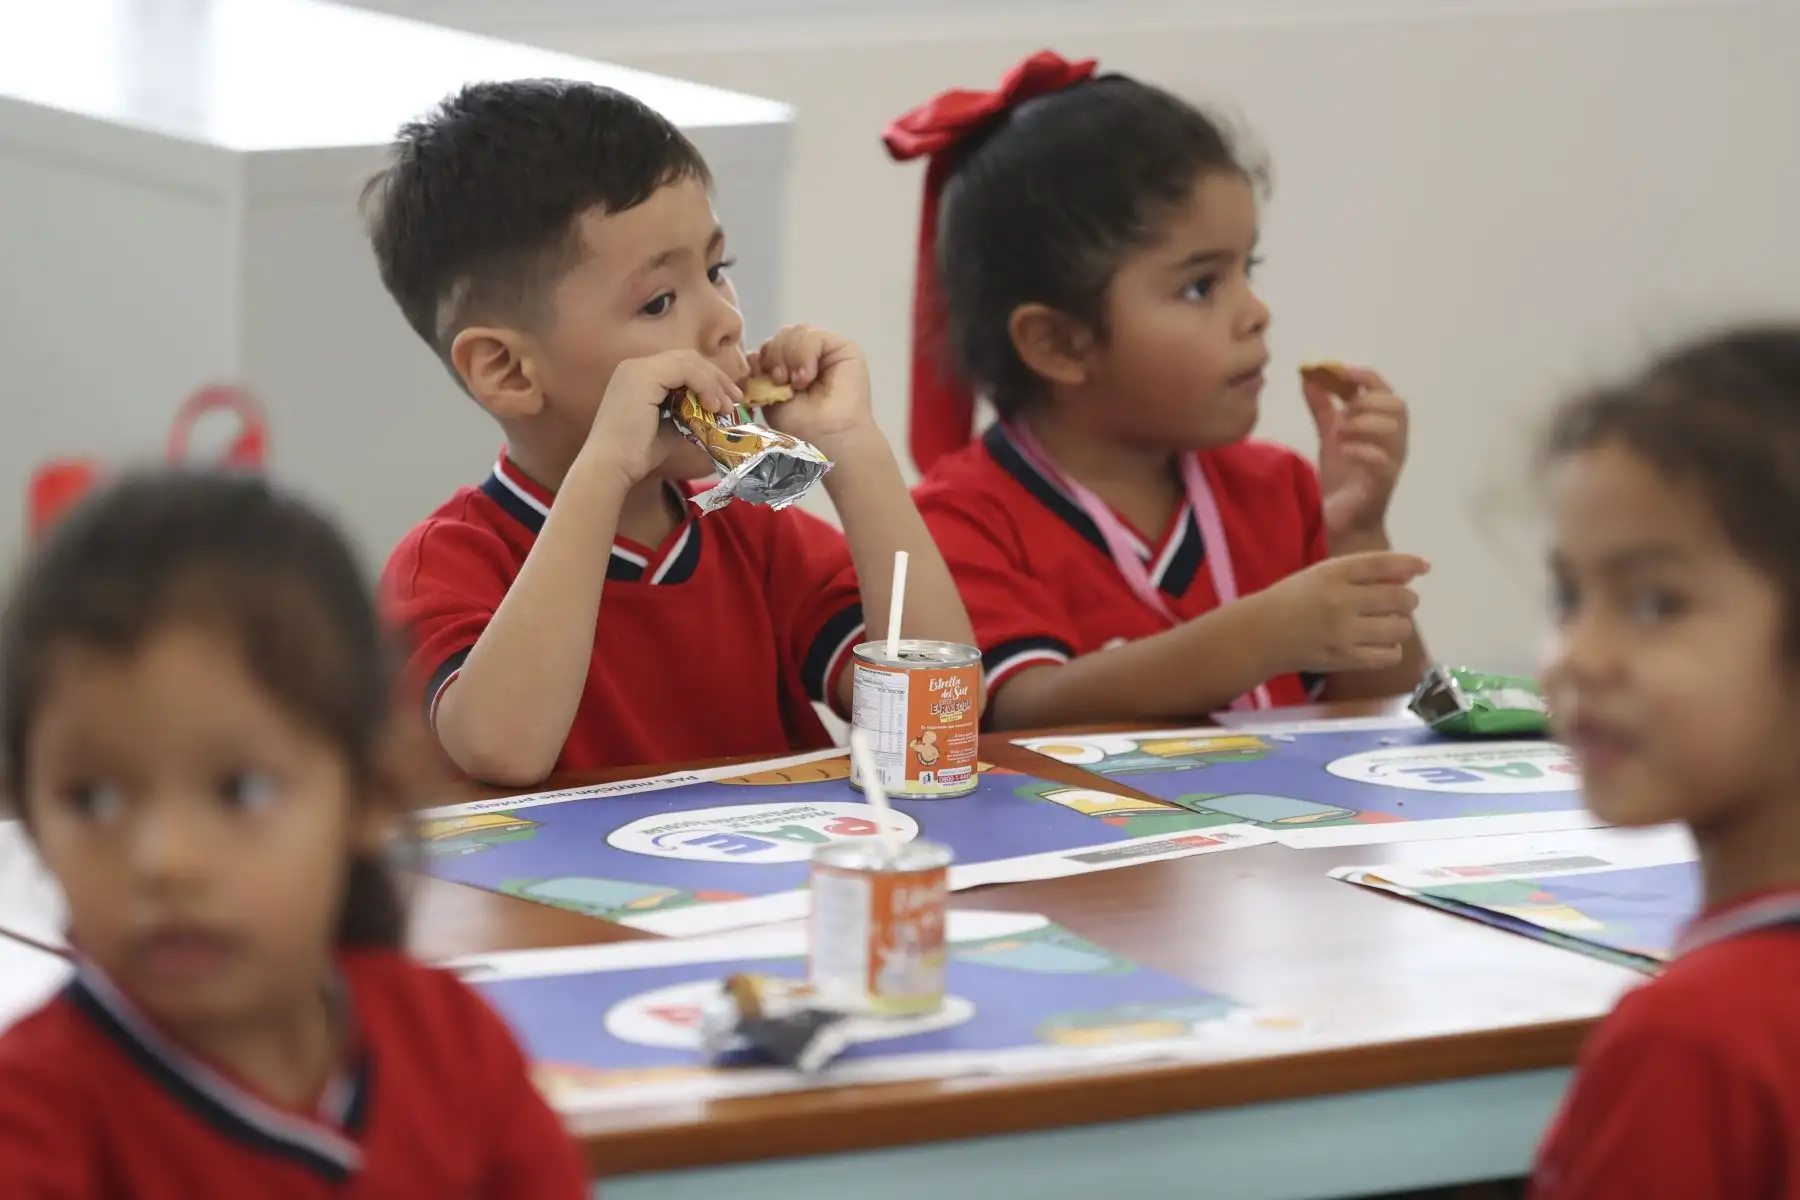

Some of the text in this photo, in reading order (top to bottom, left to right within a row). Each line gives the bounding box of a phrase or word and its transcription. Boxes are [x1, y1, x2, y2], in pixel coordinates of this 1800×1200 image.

[929, 676, 961, 691] Estrella
[953, 685, 968, 700] Sur
[655, 775, 699, 784] PAE,
[575, 781, 653, 795] nutrición
[540, 791, 573, 800] que
[681, 816, 903, 855] PAE
